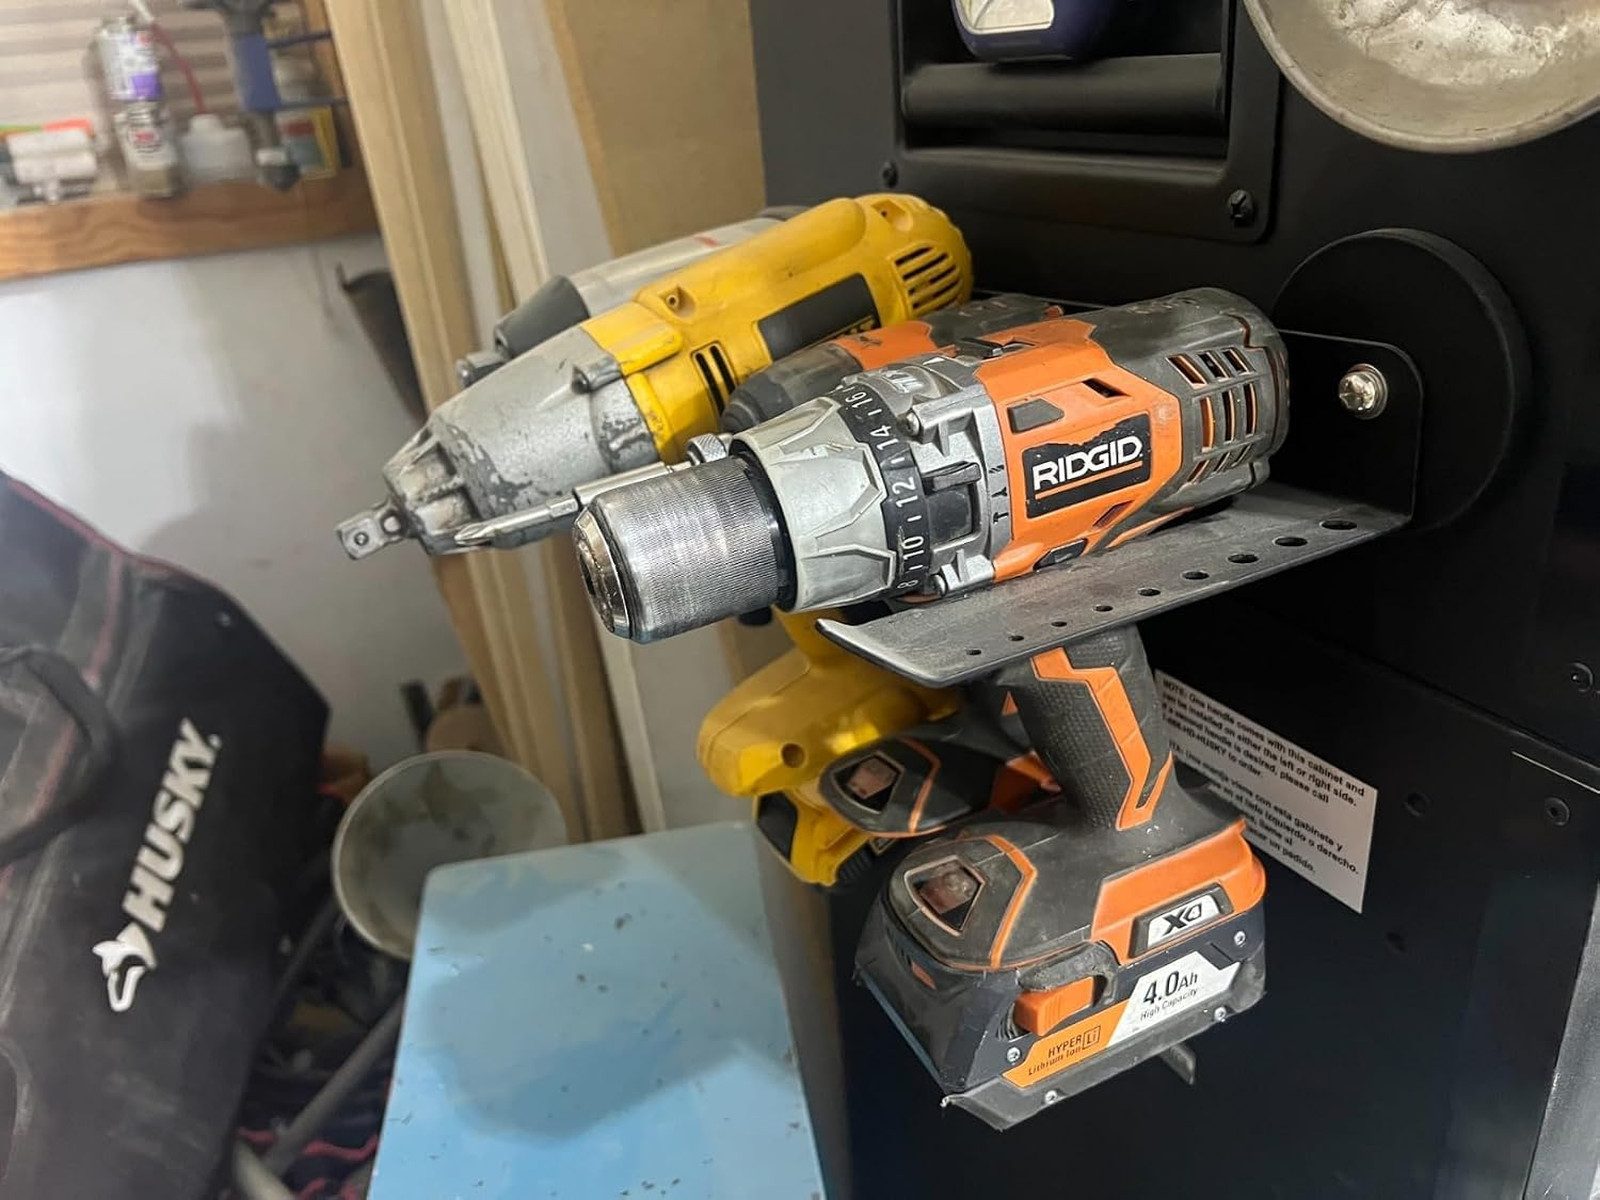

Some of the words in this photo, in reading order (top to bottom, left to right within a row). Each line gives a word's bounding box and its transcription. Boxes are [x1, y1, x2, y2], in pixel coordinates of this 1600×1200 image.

[845, 391, 873, 409] 16
[870, 424, 899, 451] 14
[1032, 435, 1143, 491] RIDGID
[892, 476, 918, 508] 12
[901, 535, 925, 561] 10
[1189, 693, 1205, 708] One
[1207, 703, 1234, 724] handle
[1237, 721, 1265, 742] comes
[1267, 736, 1286, 753] with
[1288, 749, 1305, 764] this
[1308, 760, 1343, 785] cabinet
[1346, 780, 1365, 797] and
[1228, 752, 1236, 762] to
[1204, 725, 1232, 747] handle
[1234, 742, 1242, 753] is
[1243, 748, 1277, 775] desired,
[1280, 770, 1310, 792] please
[1312, 788, 1329, 803] call
[1224, 726, 1235, 737] on
[1237, 732, 1261, 751] either
[1263, 747, 1278, 761] the
[1280, 756, 1294, 771] left
[1296, 767, 1306, 777] or
[1308, 773, 1331, 792] right
[1333, 784, 1357, 806] side.
[122, 717, 217, 932] HUSKY
[1255, 794, 1271, 808] con
[1294, 817, 1334, 846] gabinete
[1335, 842, 1344, 853] y
[1308, 838, 1315, 847] o
[1316, 843, 1359, 875] derecho.
[1140, 1004, 1160, 1021] High
[1162, 988, 1198, 1010] Capacity
[1143, 970, 1198, 1005] 4.0Ah
[1048, 1035, 1082, 1058] HYPER
[1028, 1054, 1064, 1076] Lithium
